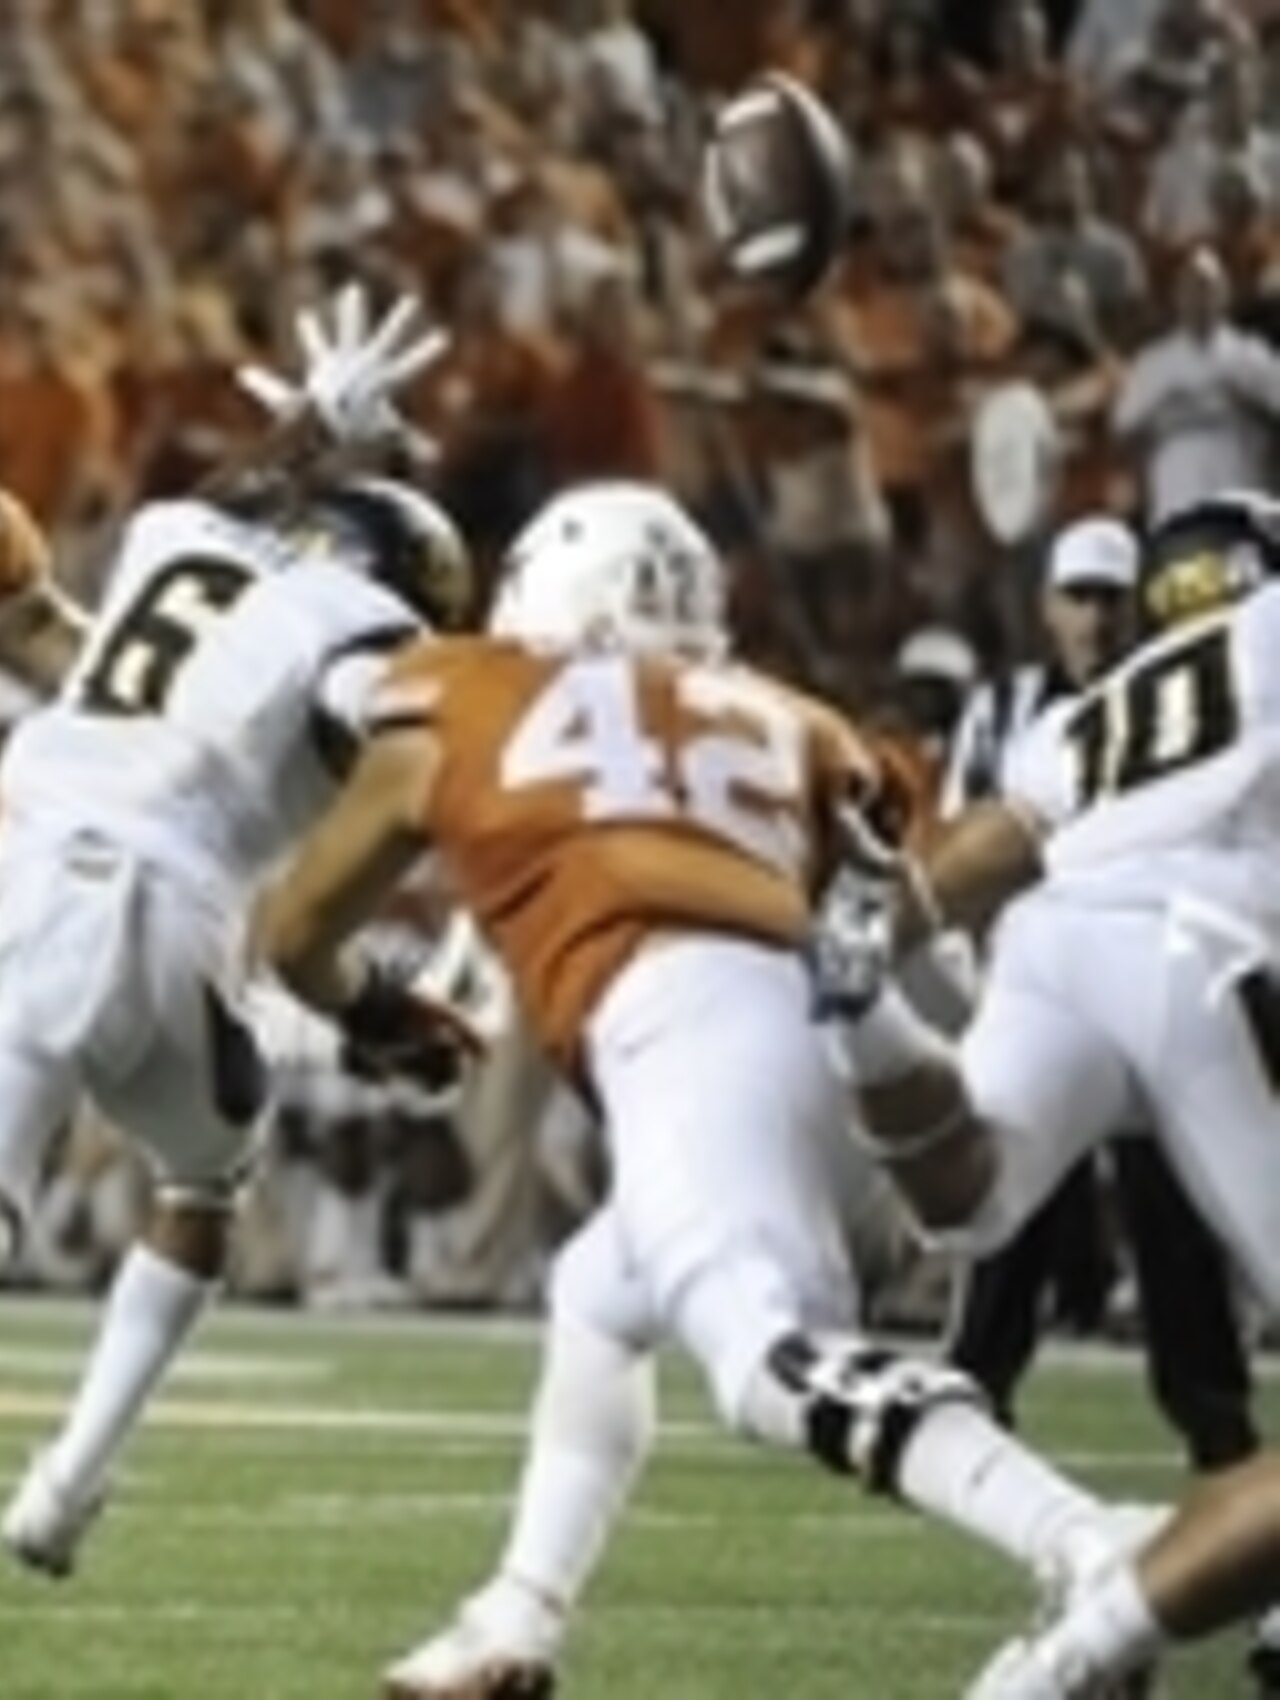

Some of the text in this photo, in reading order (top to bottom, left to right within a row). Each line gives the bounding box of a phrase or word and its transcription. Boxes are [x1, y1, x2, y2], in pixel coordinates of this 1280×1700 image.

[72, 548, 261, 720] 6
[1063, 624, 1241, 813] 10
[500, 652, 812, 872] 42
